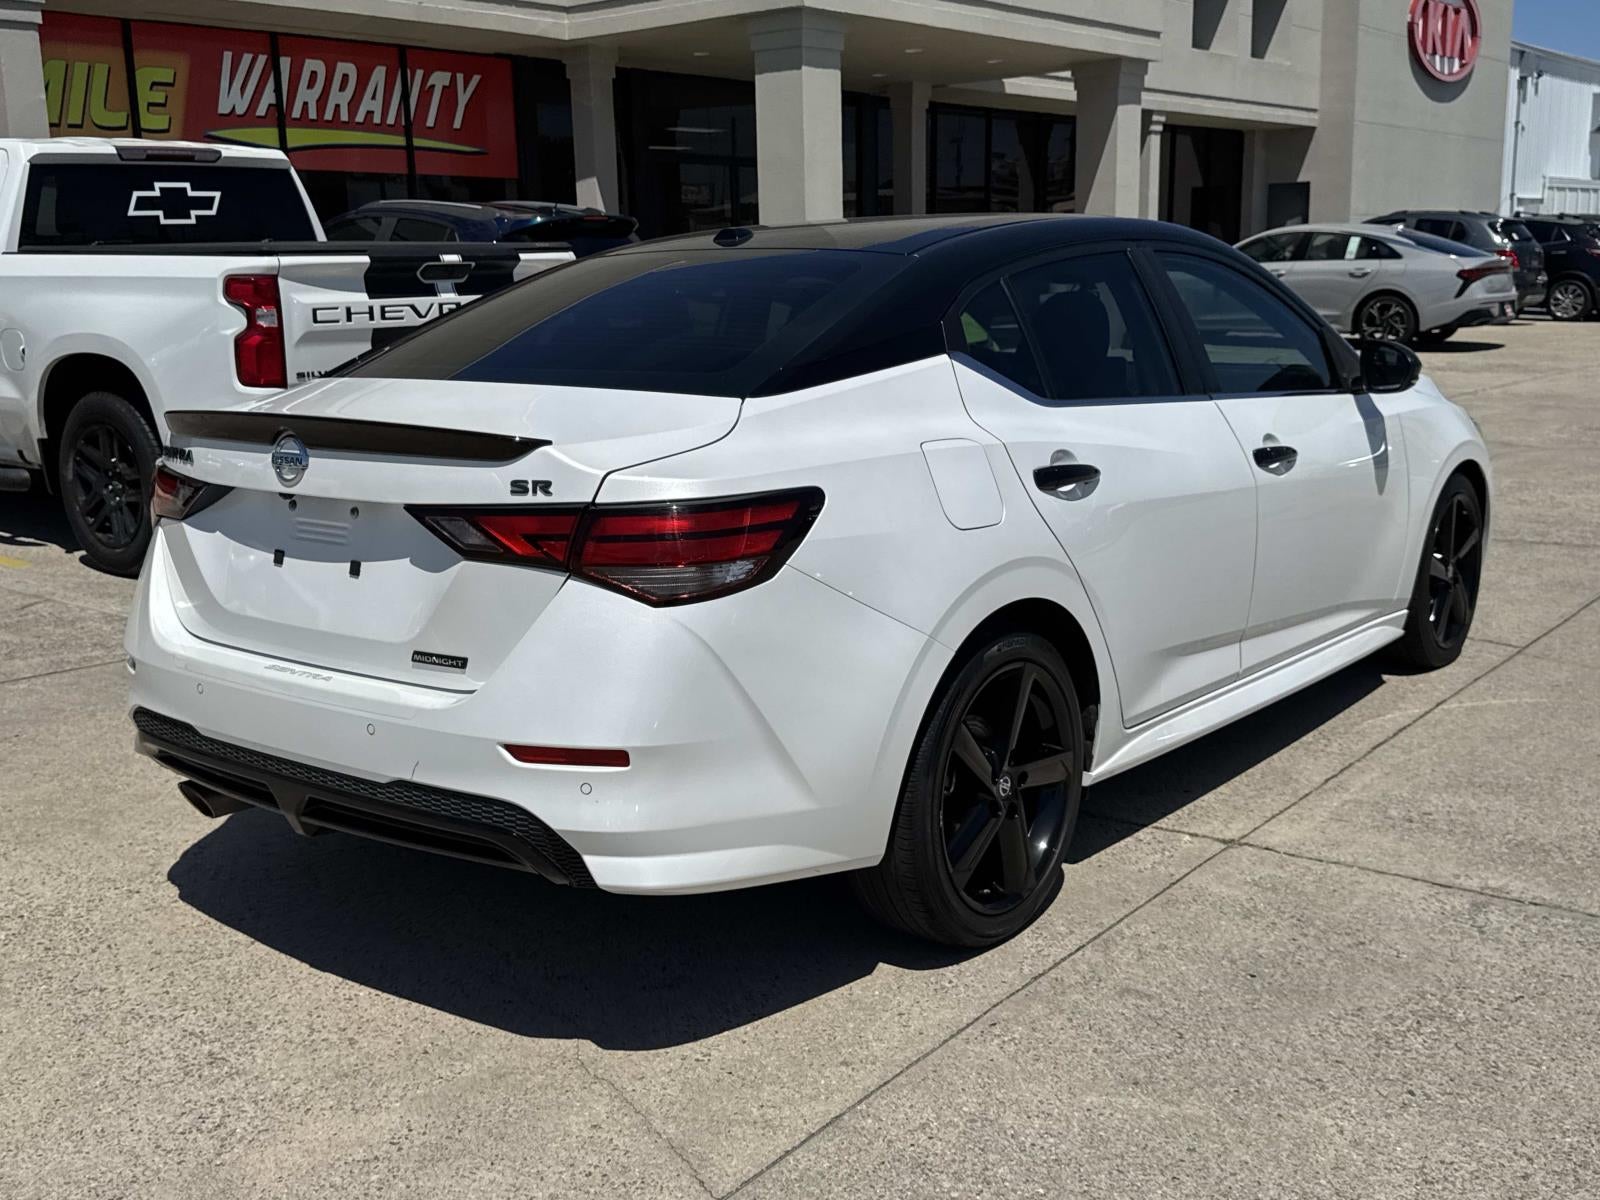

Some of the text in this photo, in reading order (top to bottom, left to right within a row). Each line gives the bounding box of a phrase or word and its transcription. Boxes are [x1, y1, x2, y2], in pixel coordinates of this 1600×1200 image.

[217, 50, 481, 130] WARRANTY
[510, 479, 553, 497] SR
[413, 654, 464, 667] MIDNIGHT
